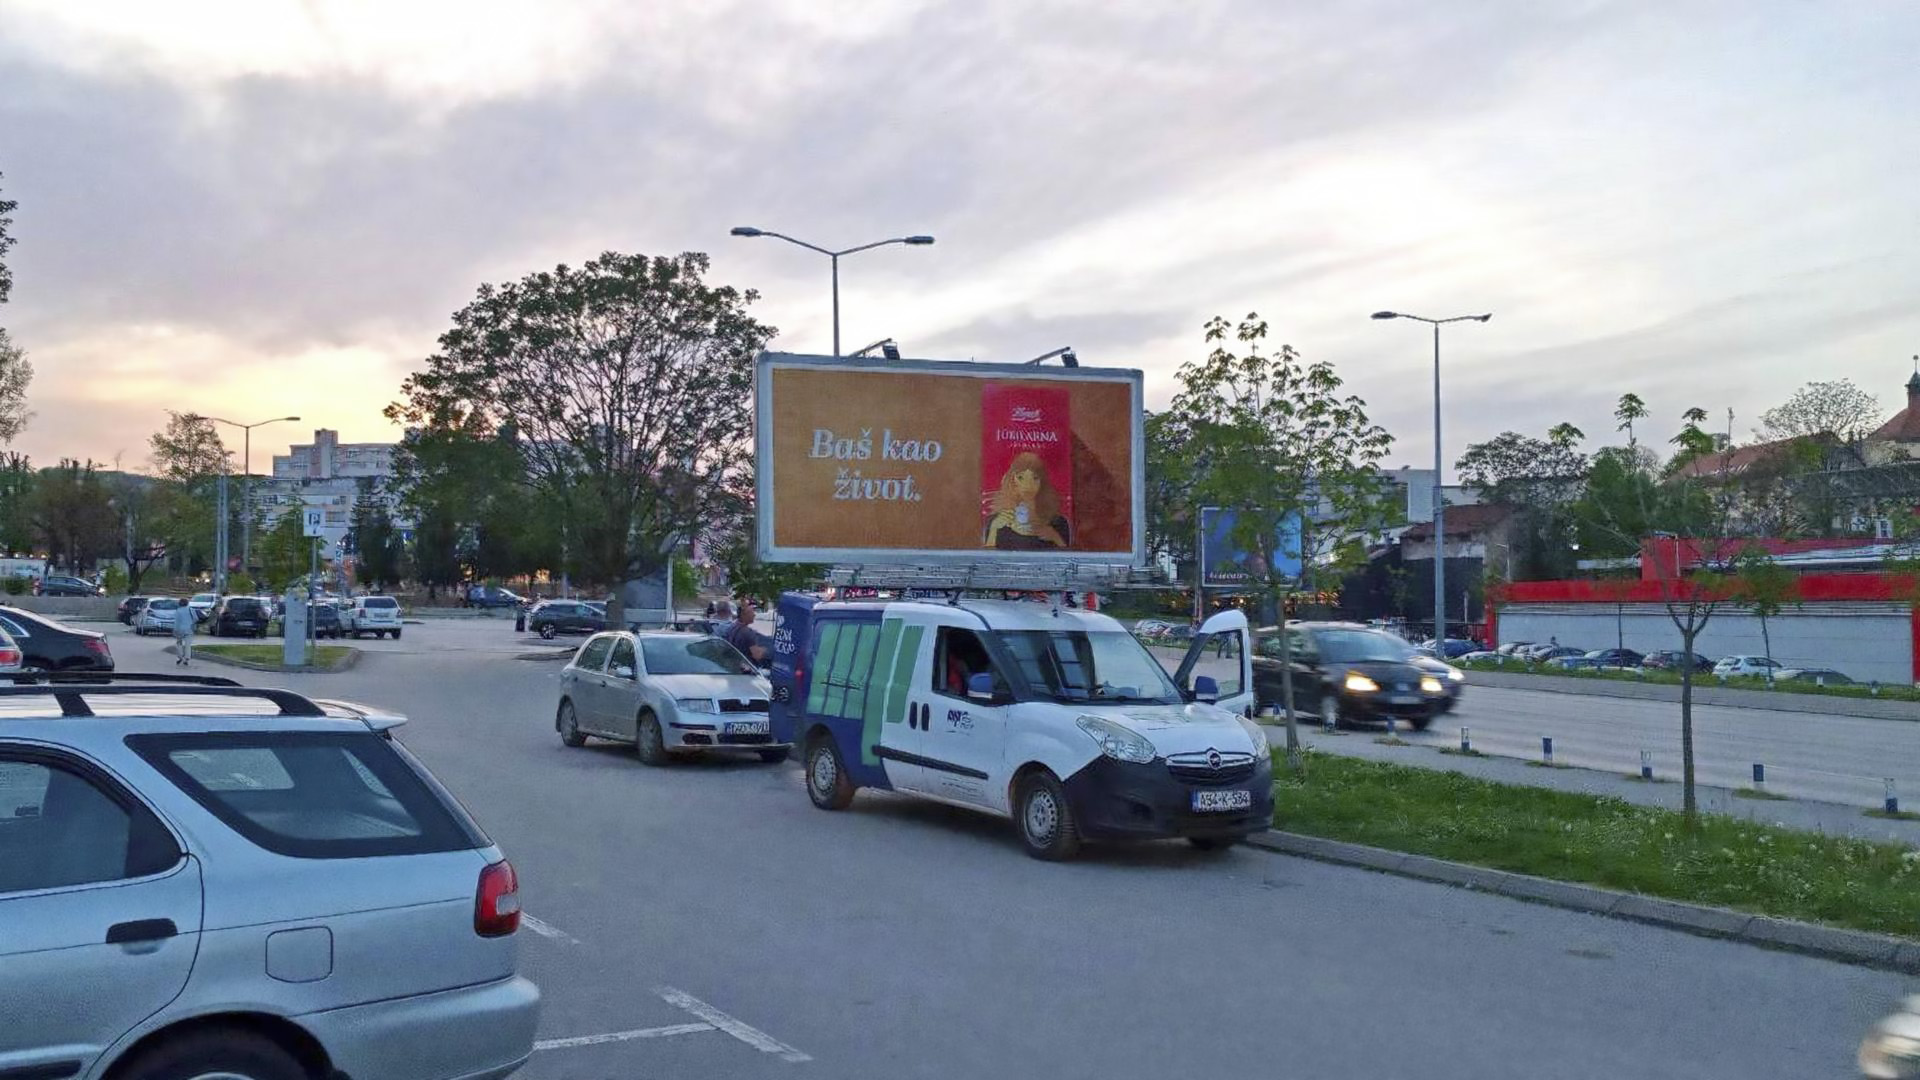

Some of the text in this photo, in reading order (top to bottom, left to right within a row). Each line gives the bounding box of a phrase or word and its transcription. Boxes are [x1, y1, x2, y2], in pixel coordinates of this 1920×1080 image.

[808, 427, 943, 461] Baš kao
[833, 467, 921, 501] život.
